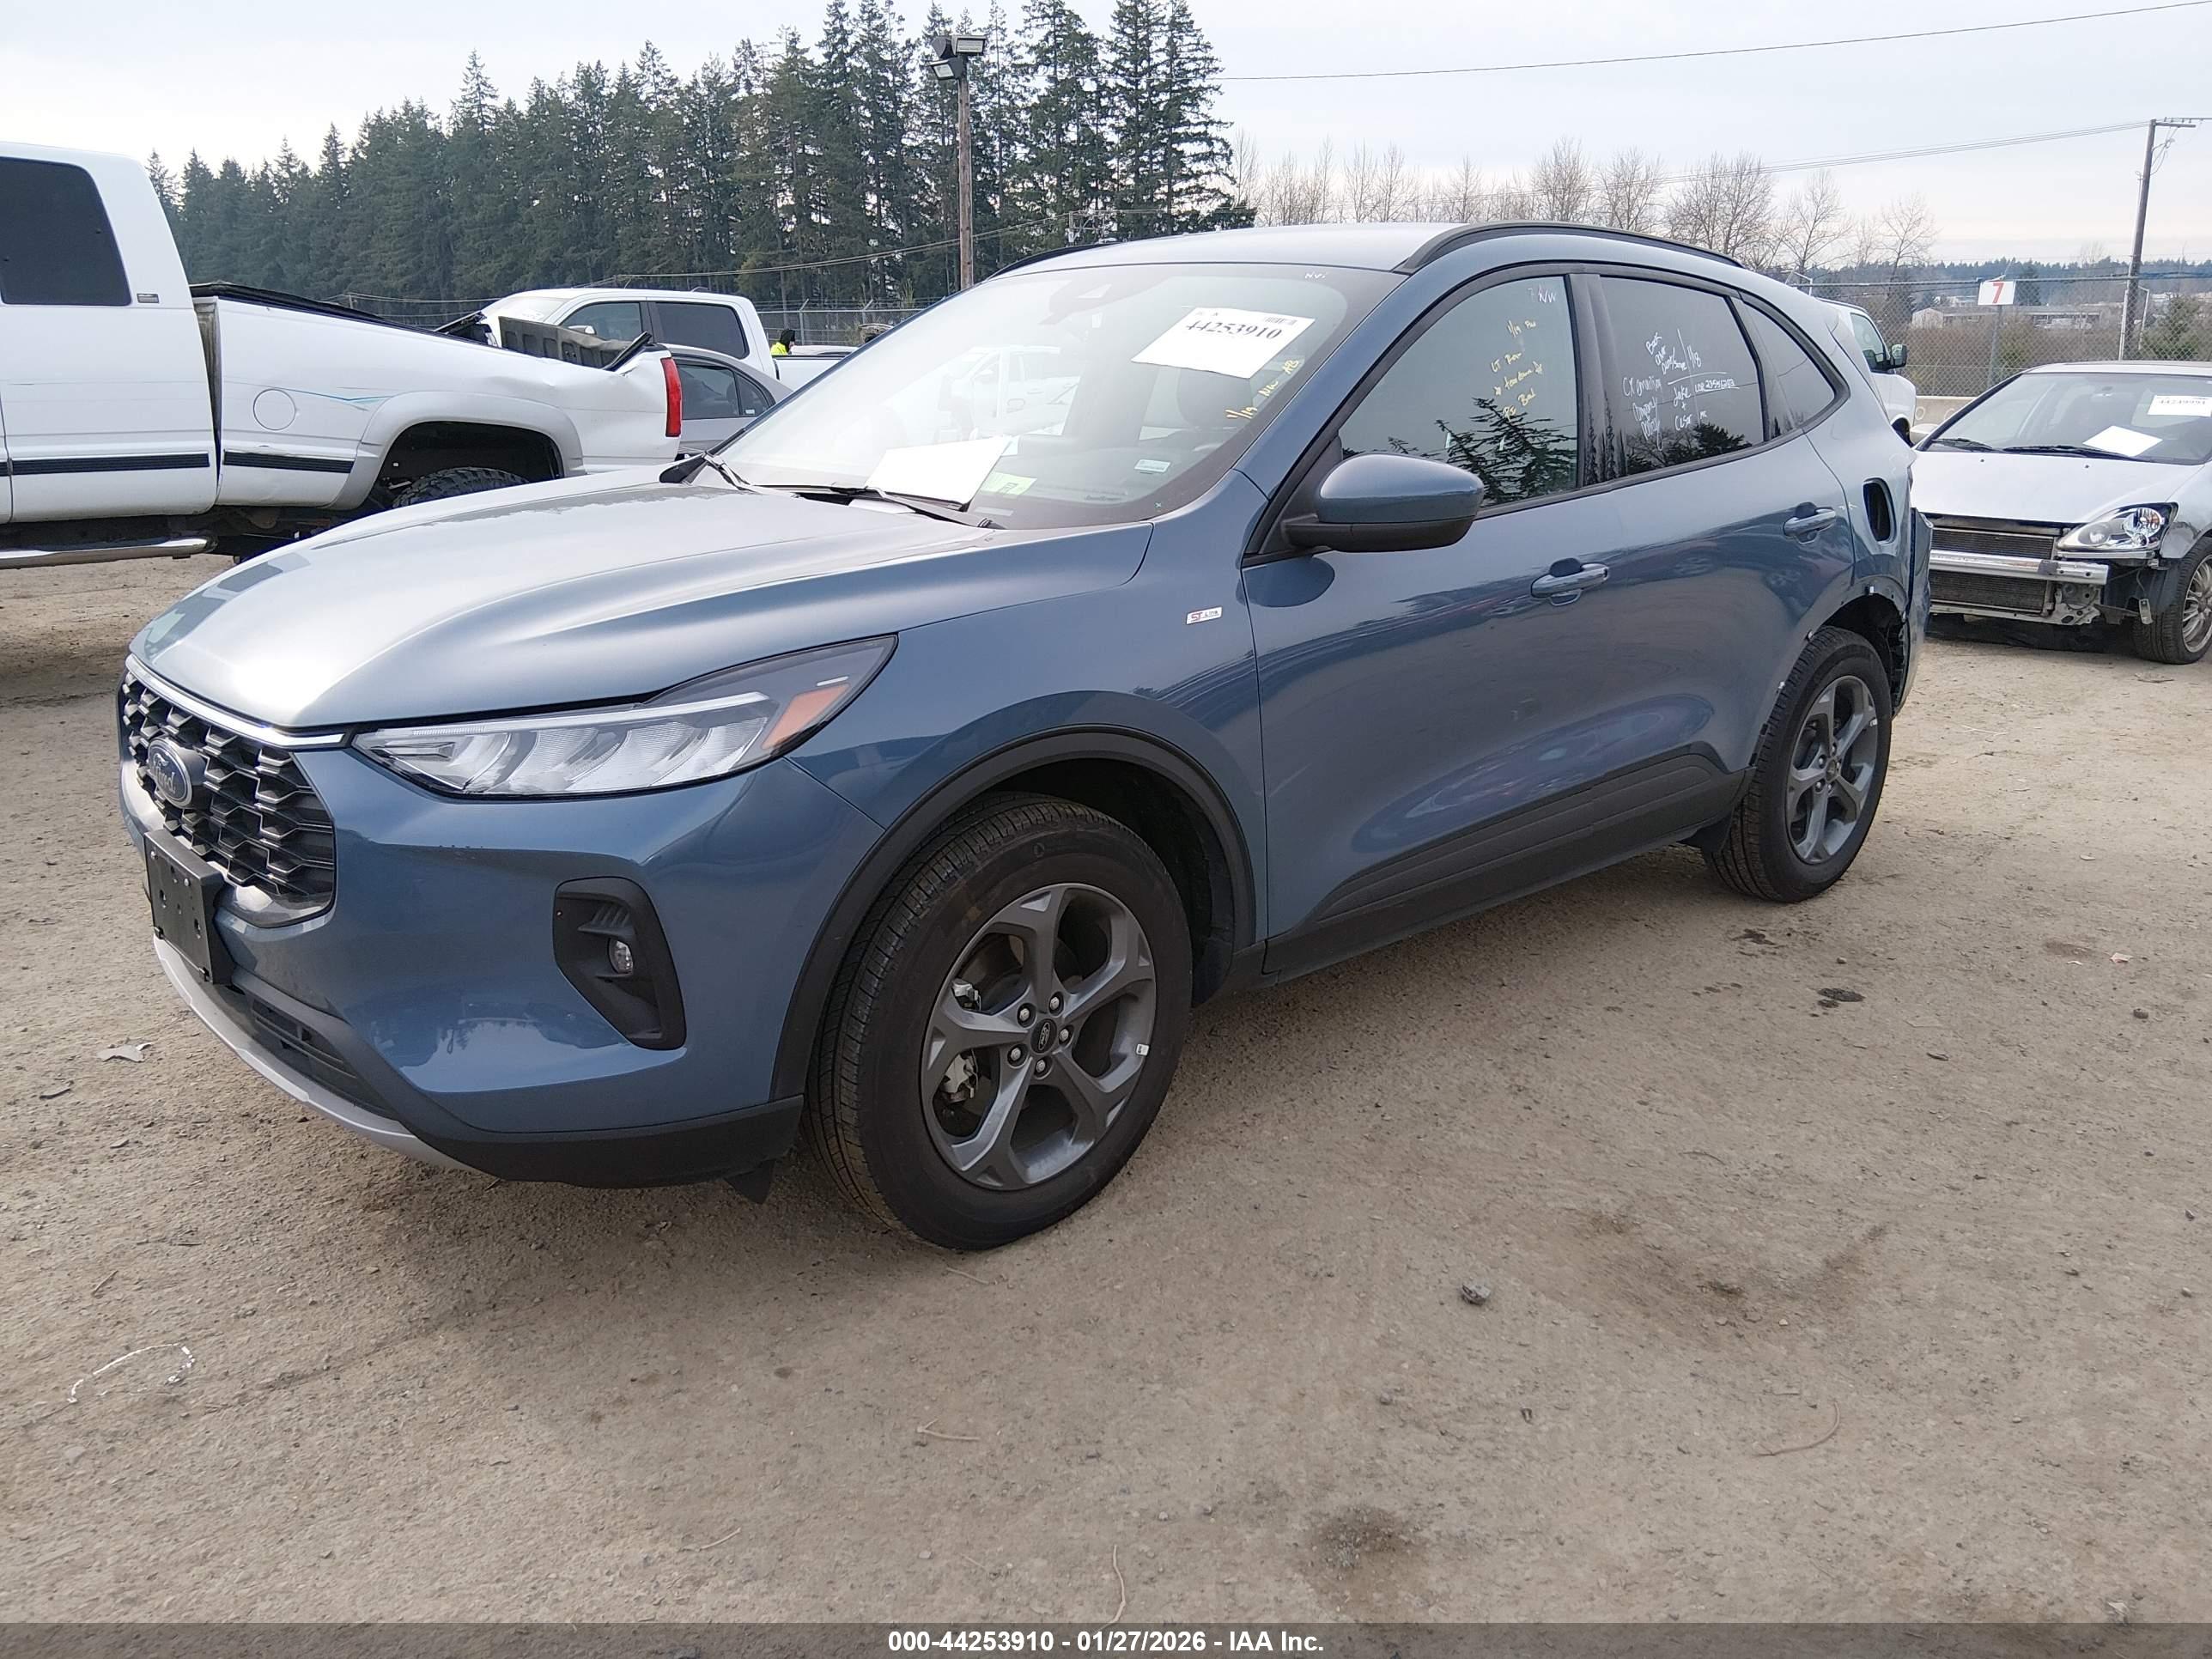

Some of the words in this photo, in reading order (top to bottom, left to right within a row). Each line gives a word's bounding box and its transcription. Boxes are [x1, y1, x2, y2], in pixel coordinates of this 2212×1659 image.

[1992, 283, 2004, 304] 7
[1185, 319, 1283, 340] 44253910
[153, 752, 176, 794] Ford
